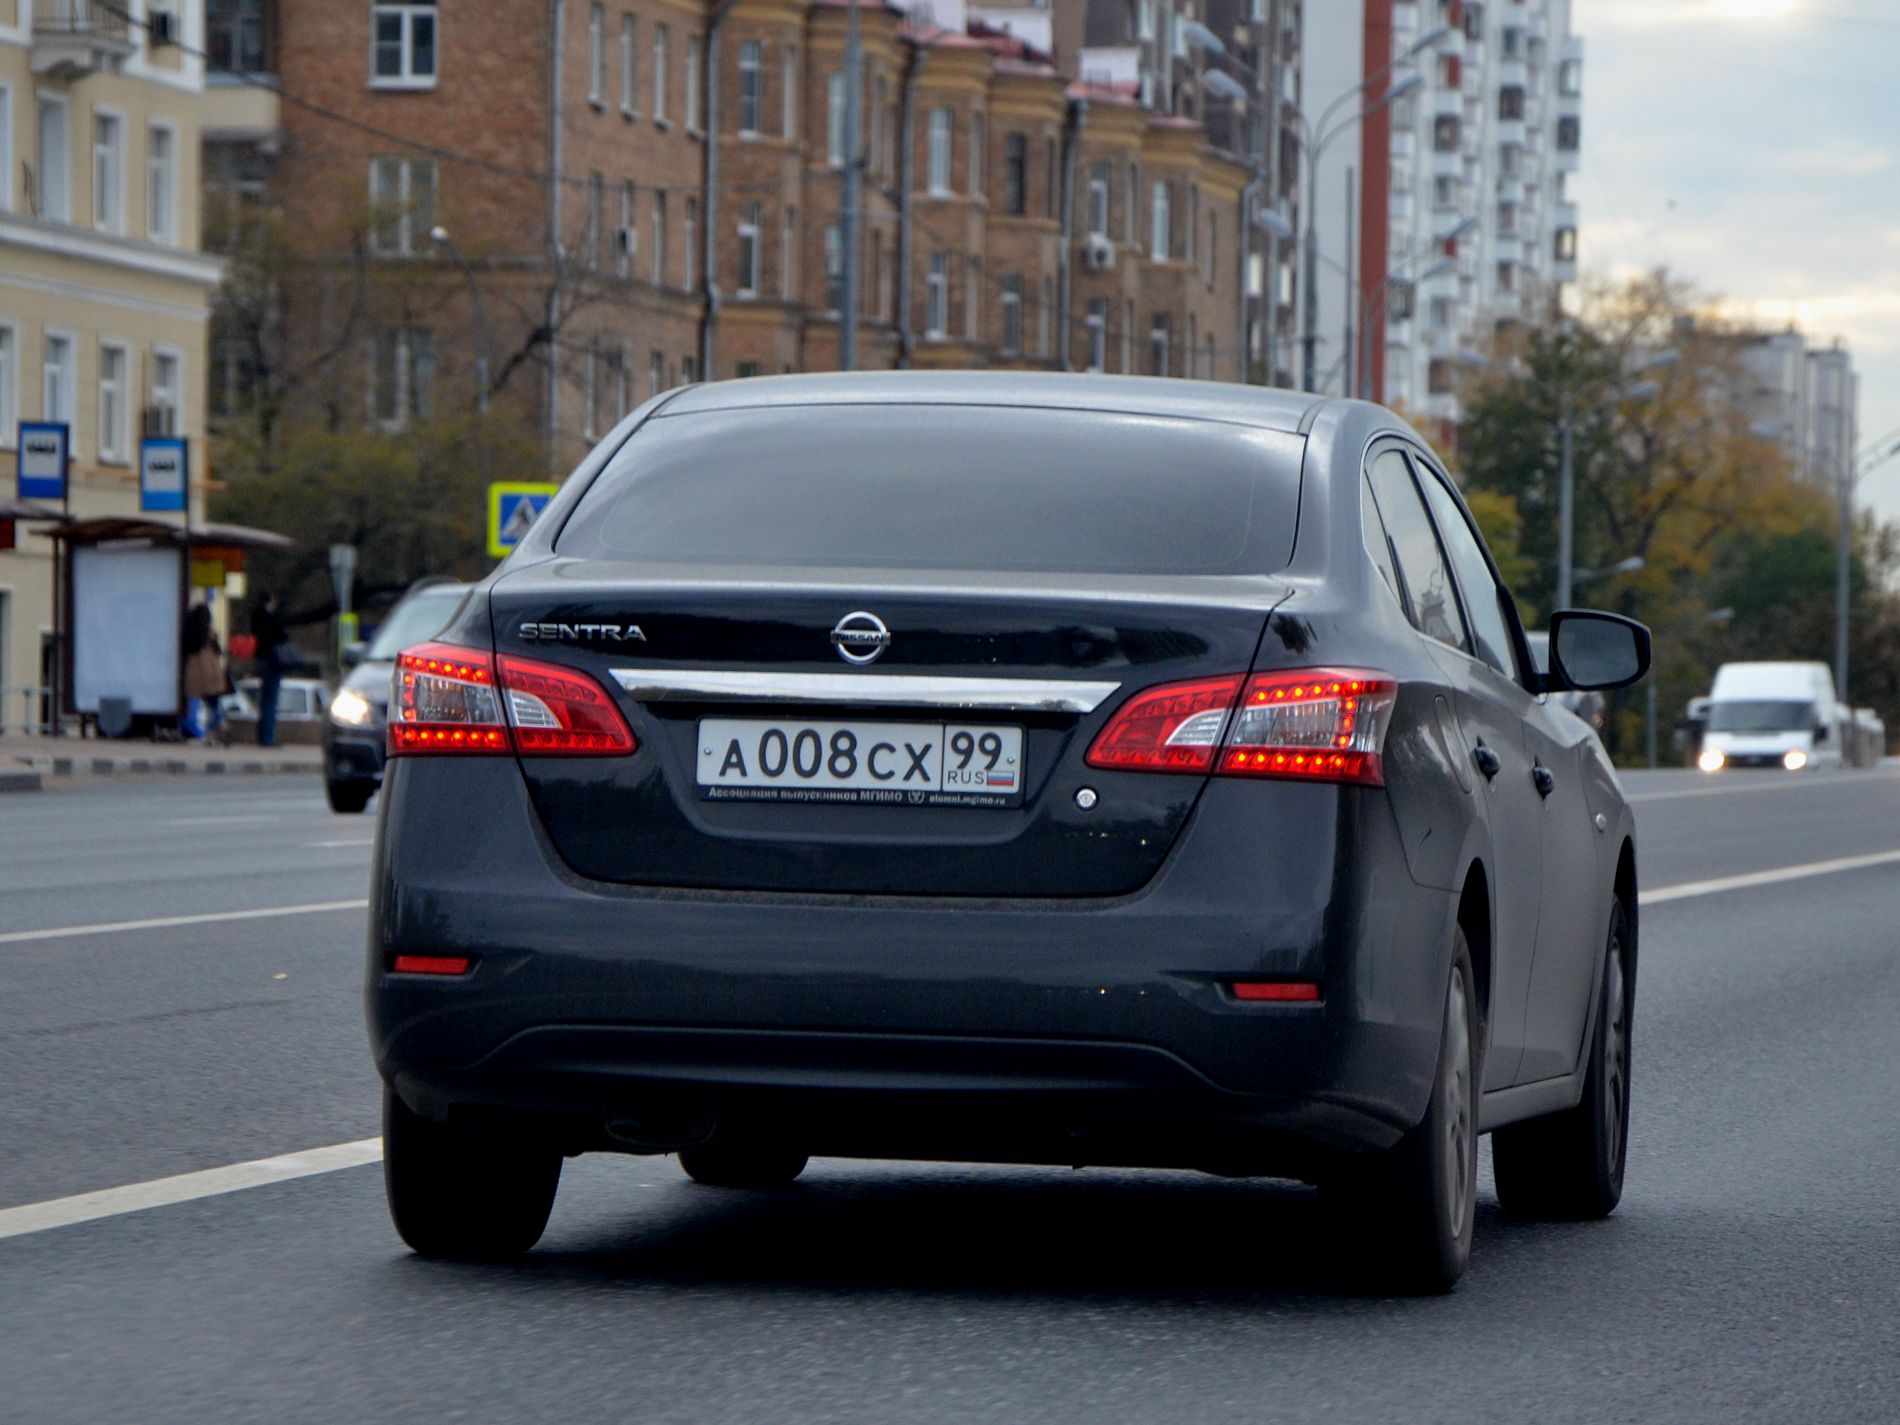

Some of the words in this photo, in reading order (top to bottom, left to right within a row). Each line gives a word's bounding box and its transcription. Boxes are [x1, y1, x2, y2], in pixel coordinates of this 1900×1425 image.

[519, 623, 647, 642] SENTRA
[835, 632, 885, 643] NISSAN
[950, 731, 1003, 771] 99
[947, 770, 985, 785] RUS
[859, 789, 903, 802] МГИМО
